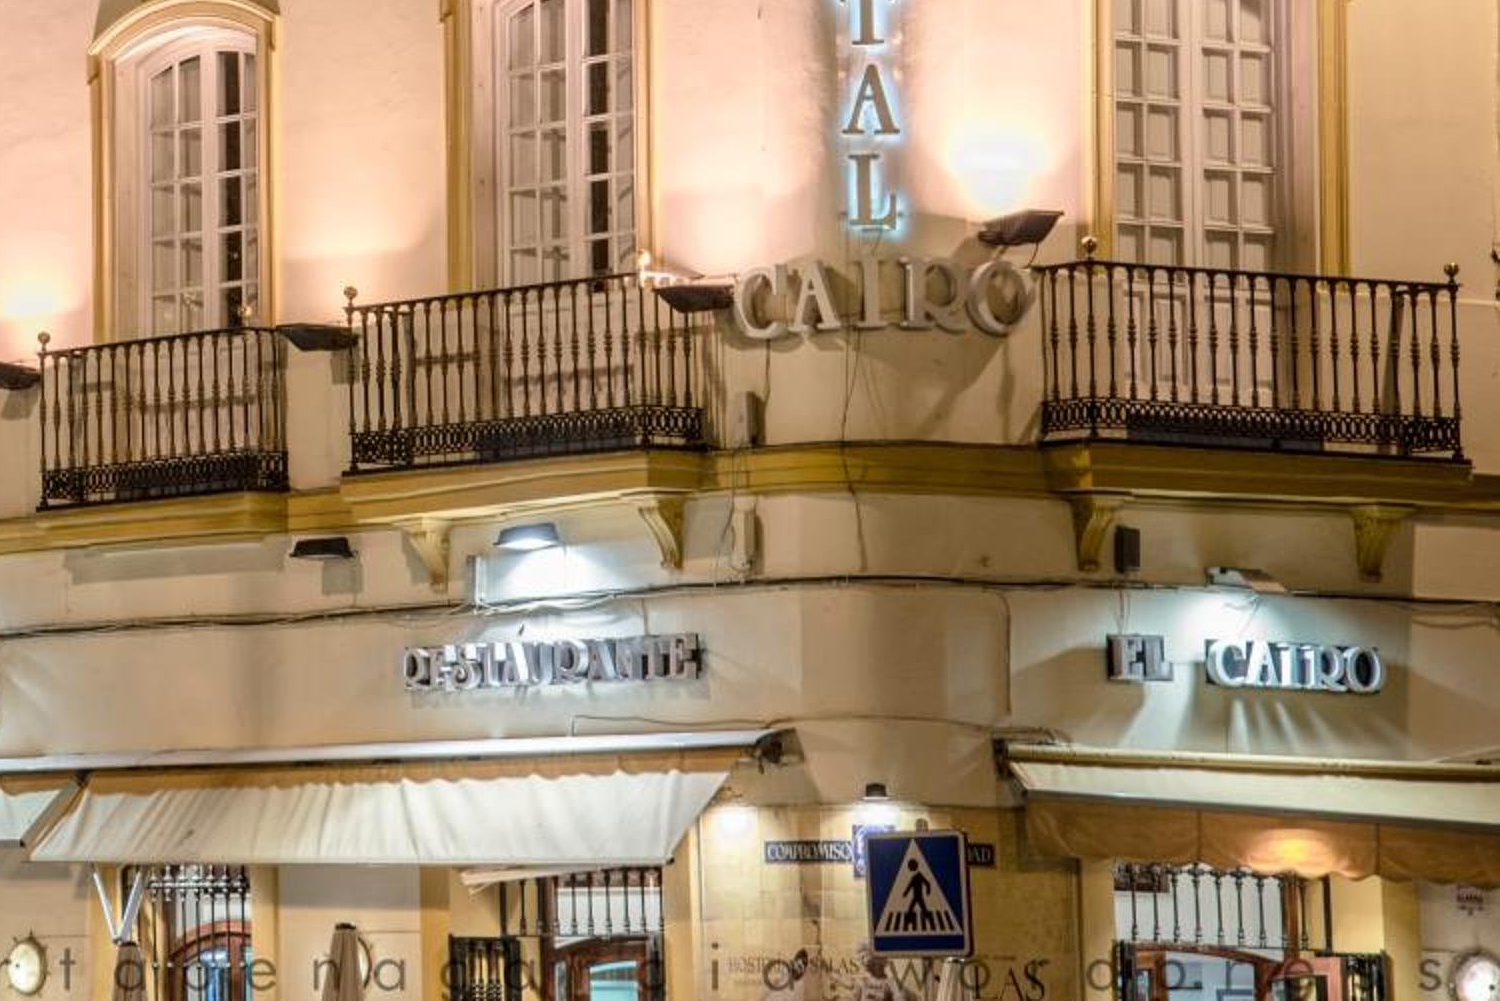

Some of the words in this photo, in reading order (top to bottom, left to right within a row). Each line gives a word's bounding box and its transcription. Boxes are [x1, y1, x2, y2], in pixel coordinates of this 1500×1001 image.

[733, 254, 1037, 337] CAIRO
[403, 633, 699, 689] RESTAURANTE
[1112, 634, 1173, 681] EL
[1205, 640, 1387, 693] CAIRO
